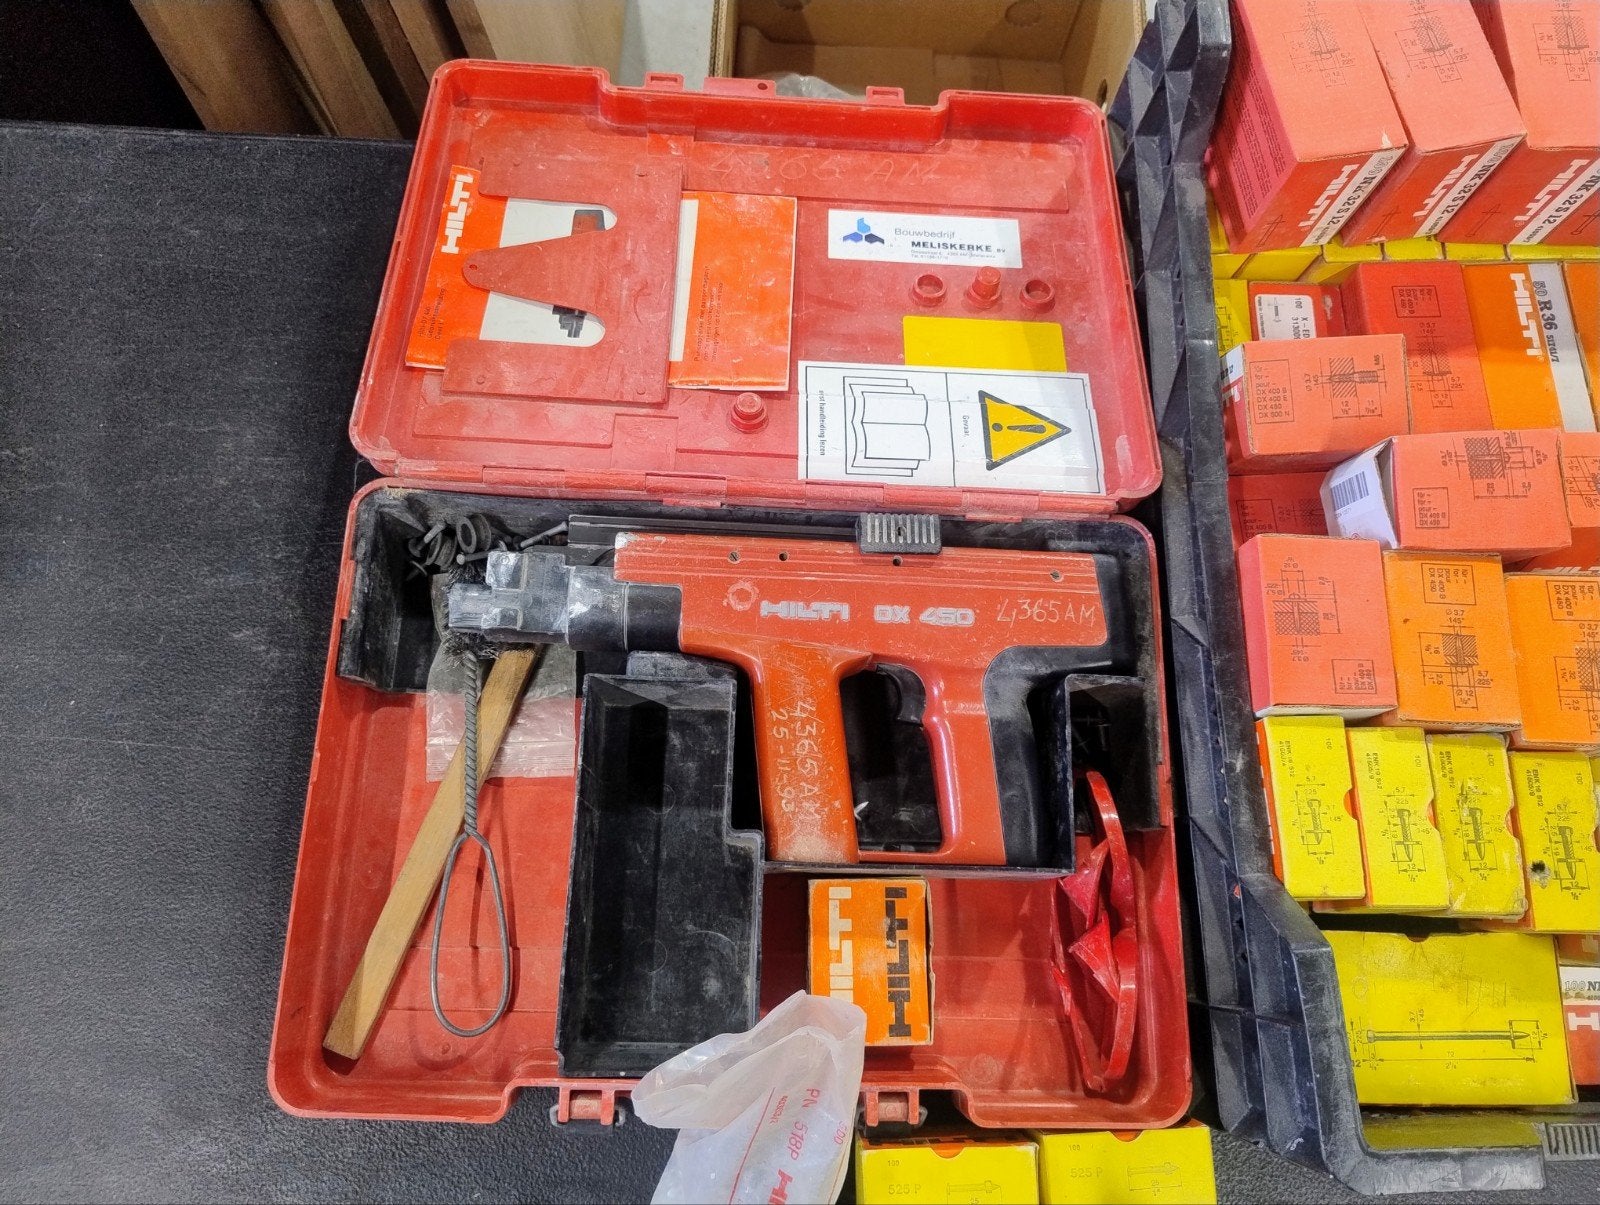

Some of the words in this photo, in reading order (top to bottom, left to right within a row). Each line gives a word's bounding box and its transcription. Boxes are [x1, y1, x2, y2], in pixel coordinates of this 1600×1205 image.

[1412, 153, 1480, 218] HILTI
[1512, 158, 1591, 222] HILTI
[1298, 164, 1361, 228] HILTI
[440, 174, 474, 255] HILTI
[894, 228, 955, 240] Bouwbedrijf
[912, 241, 992, 252] MELISKERKE
[1533, 280, 1548, 297] 50
[1510, 272, 1543, 356] HILTI
[1538, 300, 1552, 313] R
[1542, 312, 1558, 332] 36
[818, 401, 827, 443] handleiding
[1428, 568, 1436, 578] DX
[1438, 568, 1444, 578] DX
[1554, 584, 1562, 596] DX
[1562, 584, 1570, 596] DX
[760, 600, 850, 622] HILTI
[874, 604, 910, 624] DX
[918, 606, 976, 628] 450
[1444, 750, 1452, 766] ENK
[828, 886, 854, 1003] ILTI
[884, 886, 912, 1037] HILTI
[1564, 980, 1586, 992] 100
[1070, 1167, 1092, 1178] 525
[1096, 1166, 1103, 1178] P
[888, 1184, 911, 1195] 525
[914, 1184, 922, 1194] P
